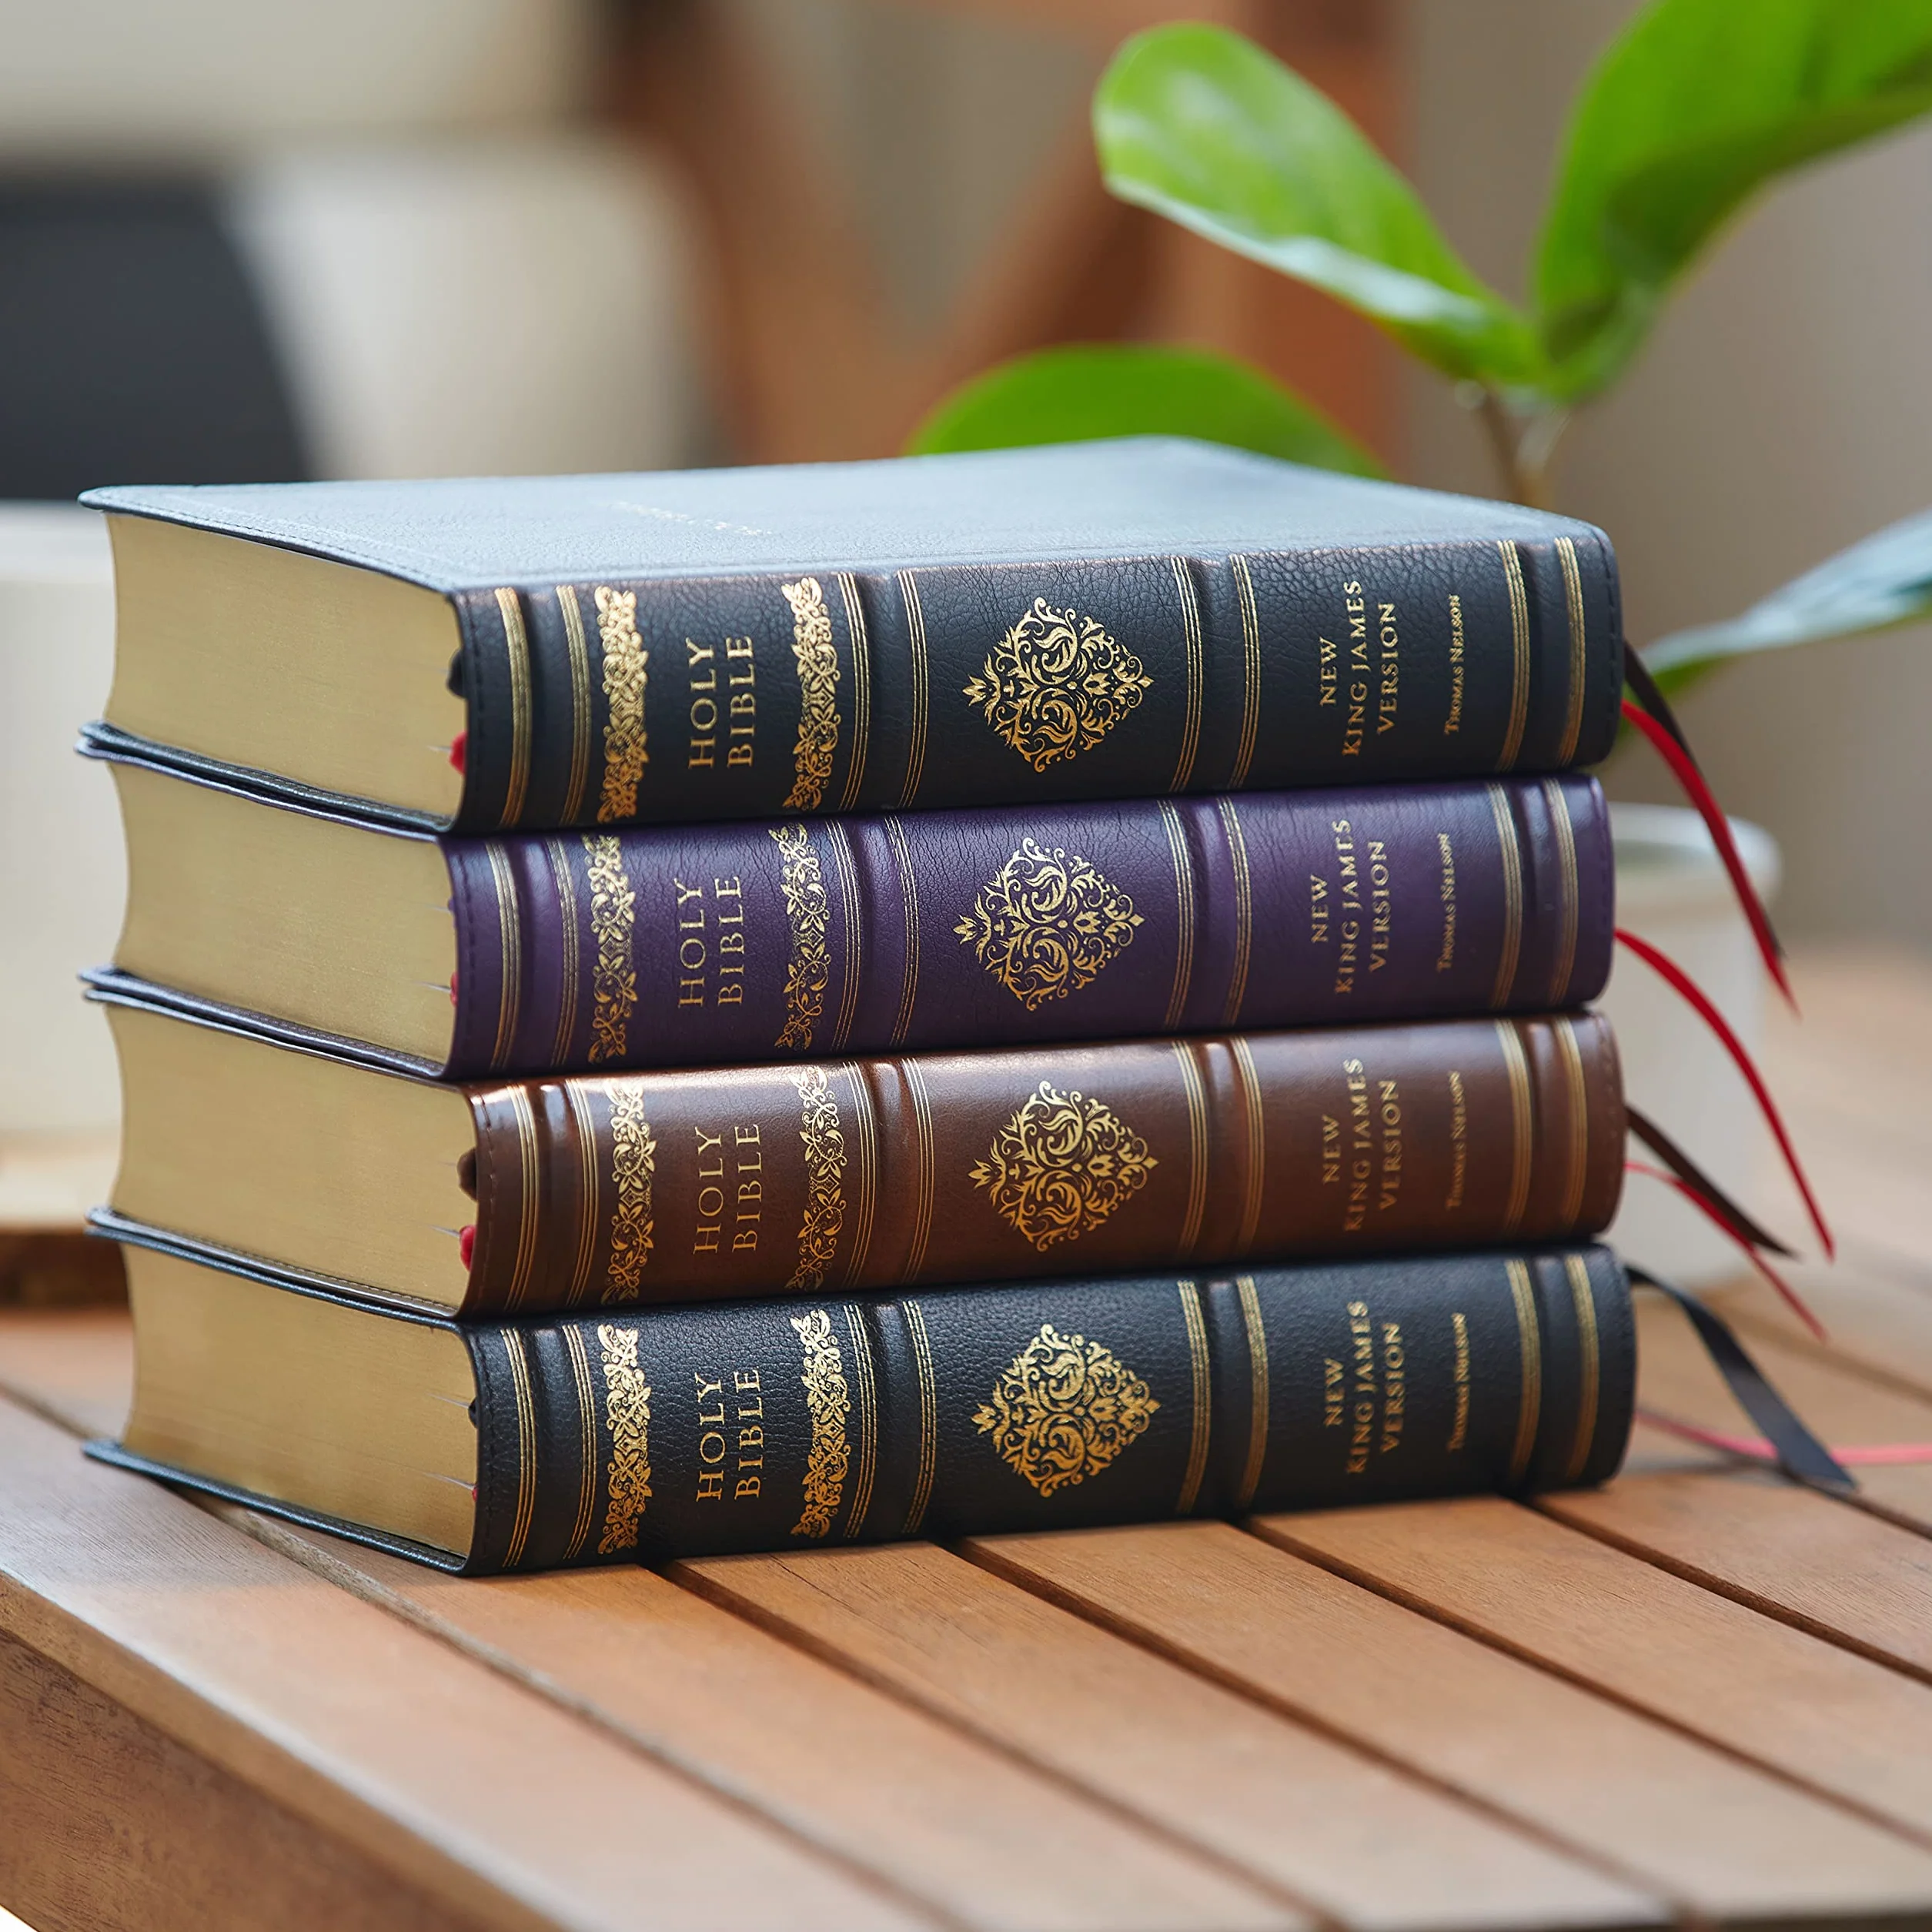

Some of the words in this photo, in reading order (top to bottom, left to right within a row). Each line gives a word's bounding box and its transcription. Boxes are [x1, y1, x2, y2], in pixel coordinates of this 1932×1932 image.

[1319, 637, 1338, 706] NEW
[1343, 580, 1372, 673] JAMES
[1377, 603, 1399, 734] VERSION
[685, 637, 717, 769] HOLY
[727, 635, 755, 767] BIBLE
[1342, 681, 1367, 756] KING
[1311, 875, 1329, 943] NEW
[1332, 819, 1362, 910] JAMES
[1369, 841, 1391, 973] VERSION
[674, 877, 704, 1008] HOLY
[715, 875, 744, 1005] BIBLE
[1335, 920, 1361, 994] KING
[1322, 1115, 1341, 1184] NEW
[1344, 1058, 1372, 1150] JAMES
[1379, 1081, 1402, 1210] VERSION
[694, 1126, 724, 1253] HOLY
[732, 1124, 761, 1252] BIBLE
[1345, 1160, 1370, 1230] KING
[1323, 1358, 1343, 1426] NEW
[1348, 1302, 1376, 1392] JAMES
[1380, 1323, 1403, 1453] VERSION
[694, 1373, 727, 1502] HOLY
[734, 1369, 763, 1499] BIBLE
[1345, 1402, 1373, 1473] KING
